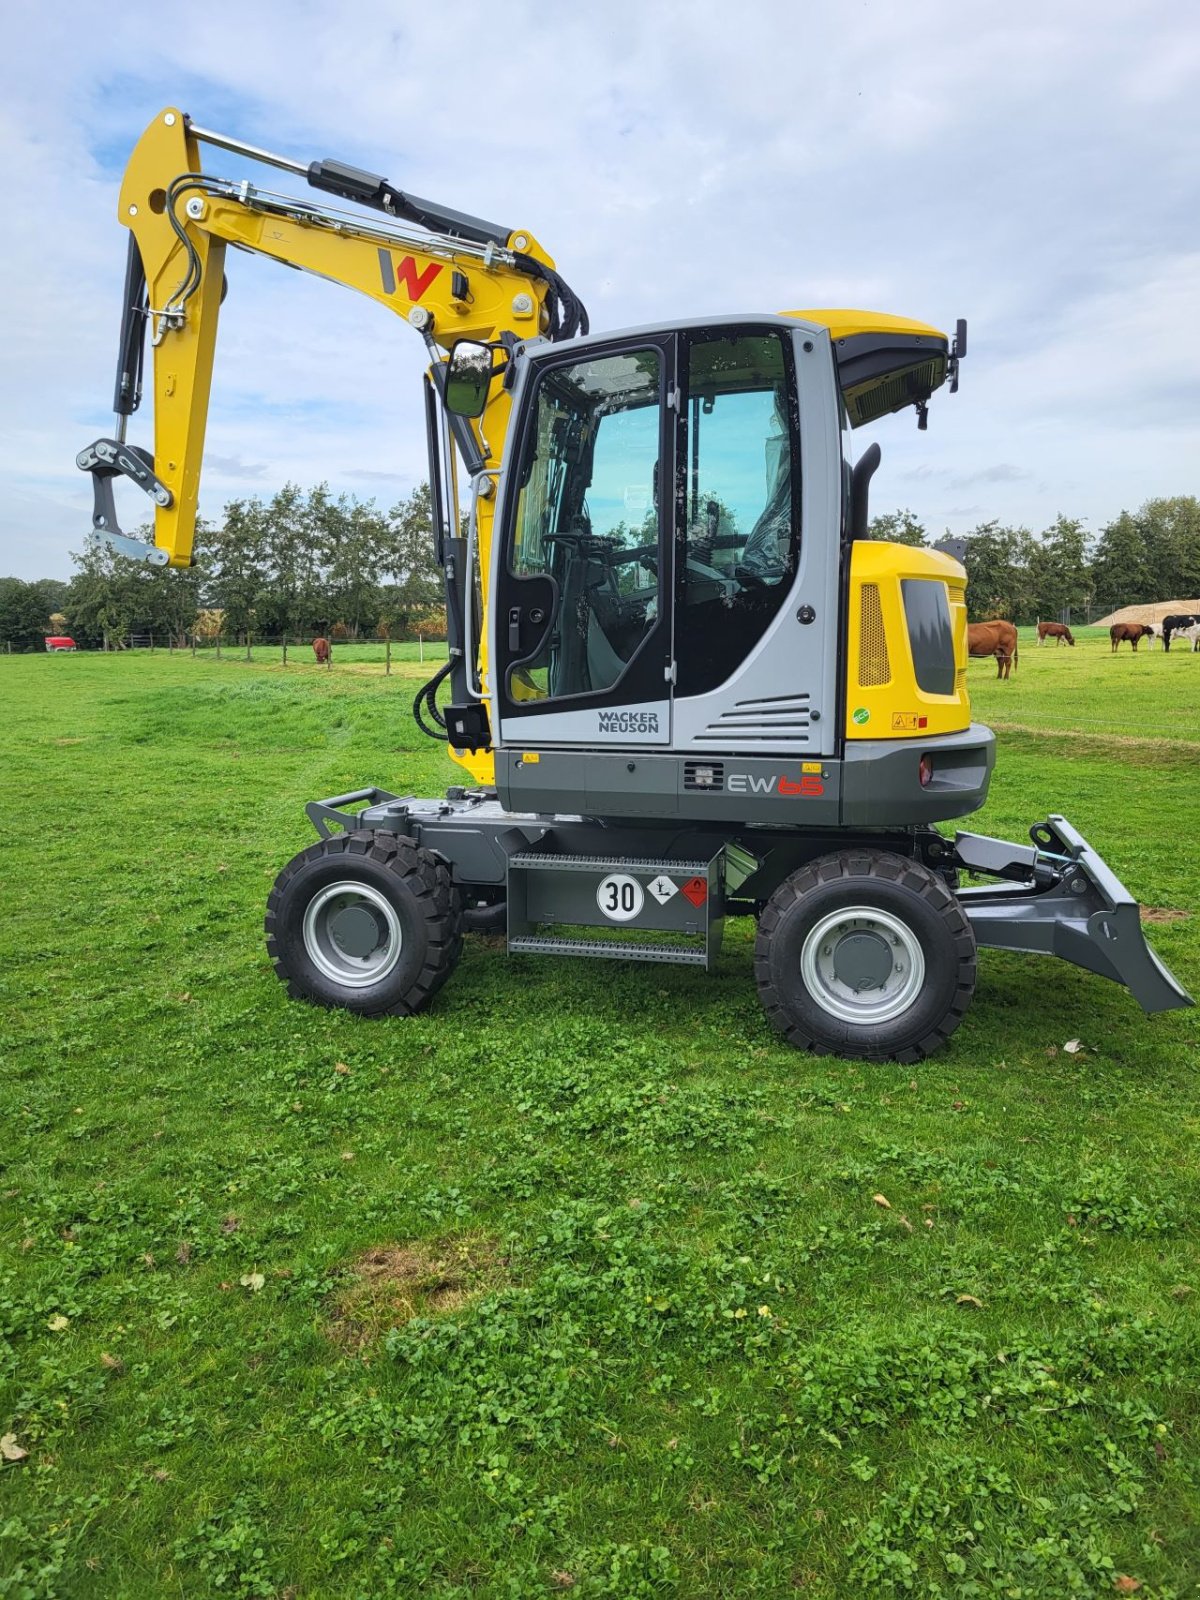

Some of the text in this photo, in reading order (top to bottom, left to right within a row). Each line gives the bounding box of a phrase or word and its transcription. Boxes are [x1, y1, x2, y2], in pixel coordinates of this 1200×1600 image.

[598, 711, 658, 722] WACKER
[599, 722, 658, 733] NEUSON
[727, 774, 824, 796] EW65
[605, 882, 634, 912] 30
